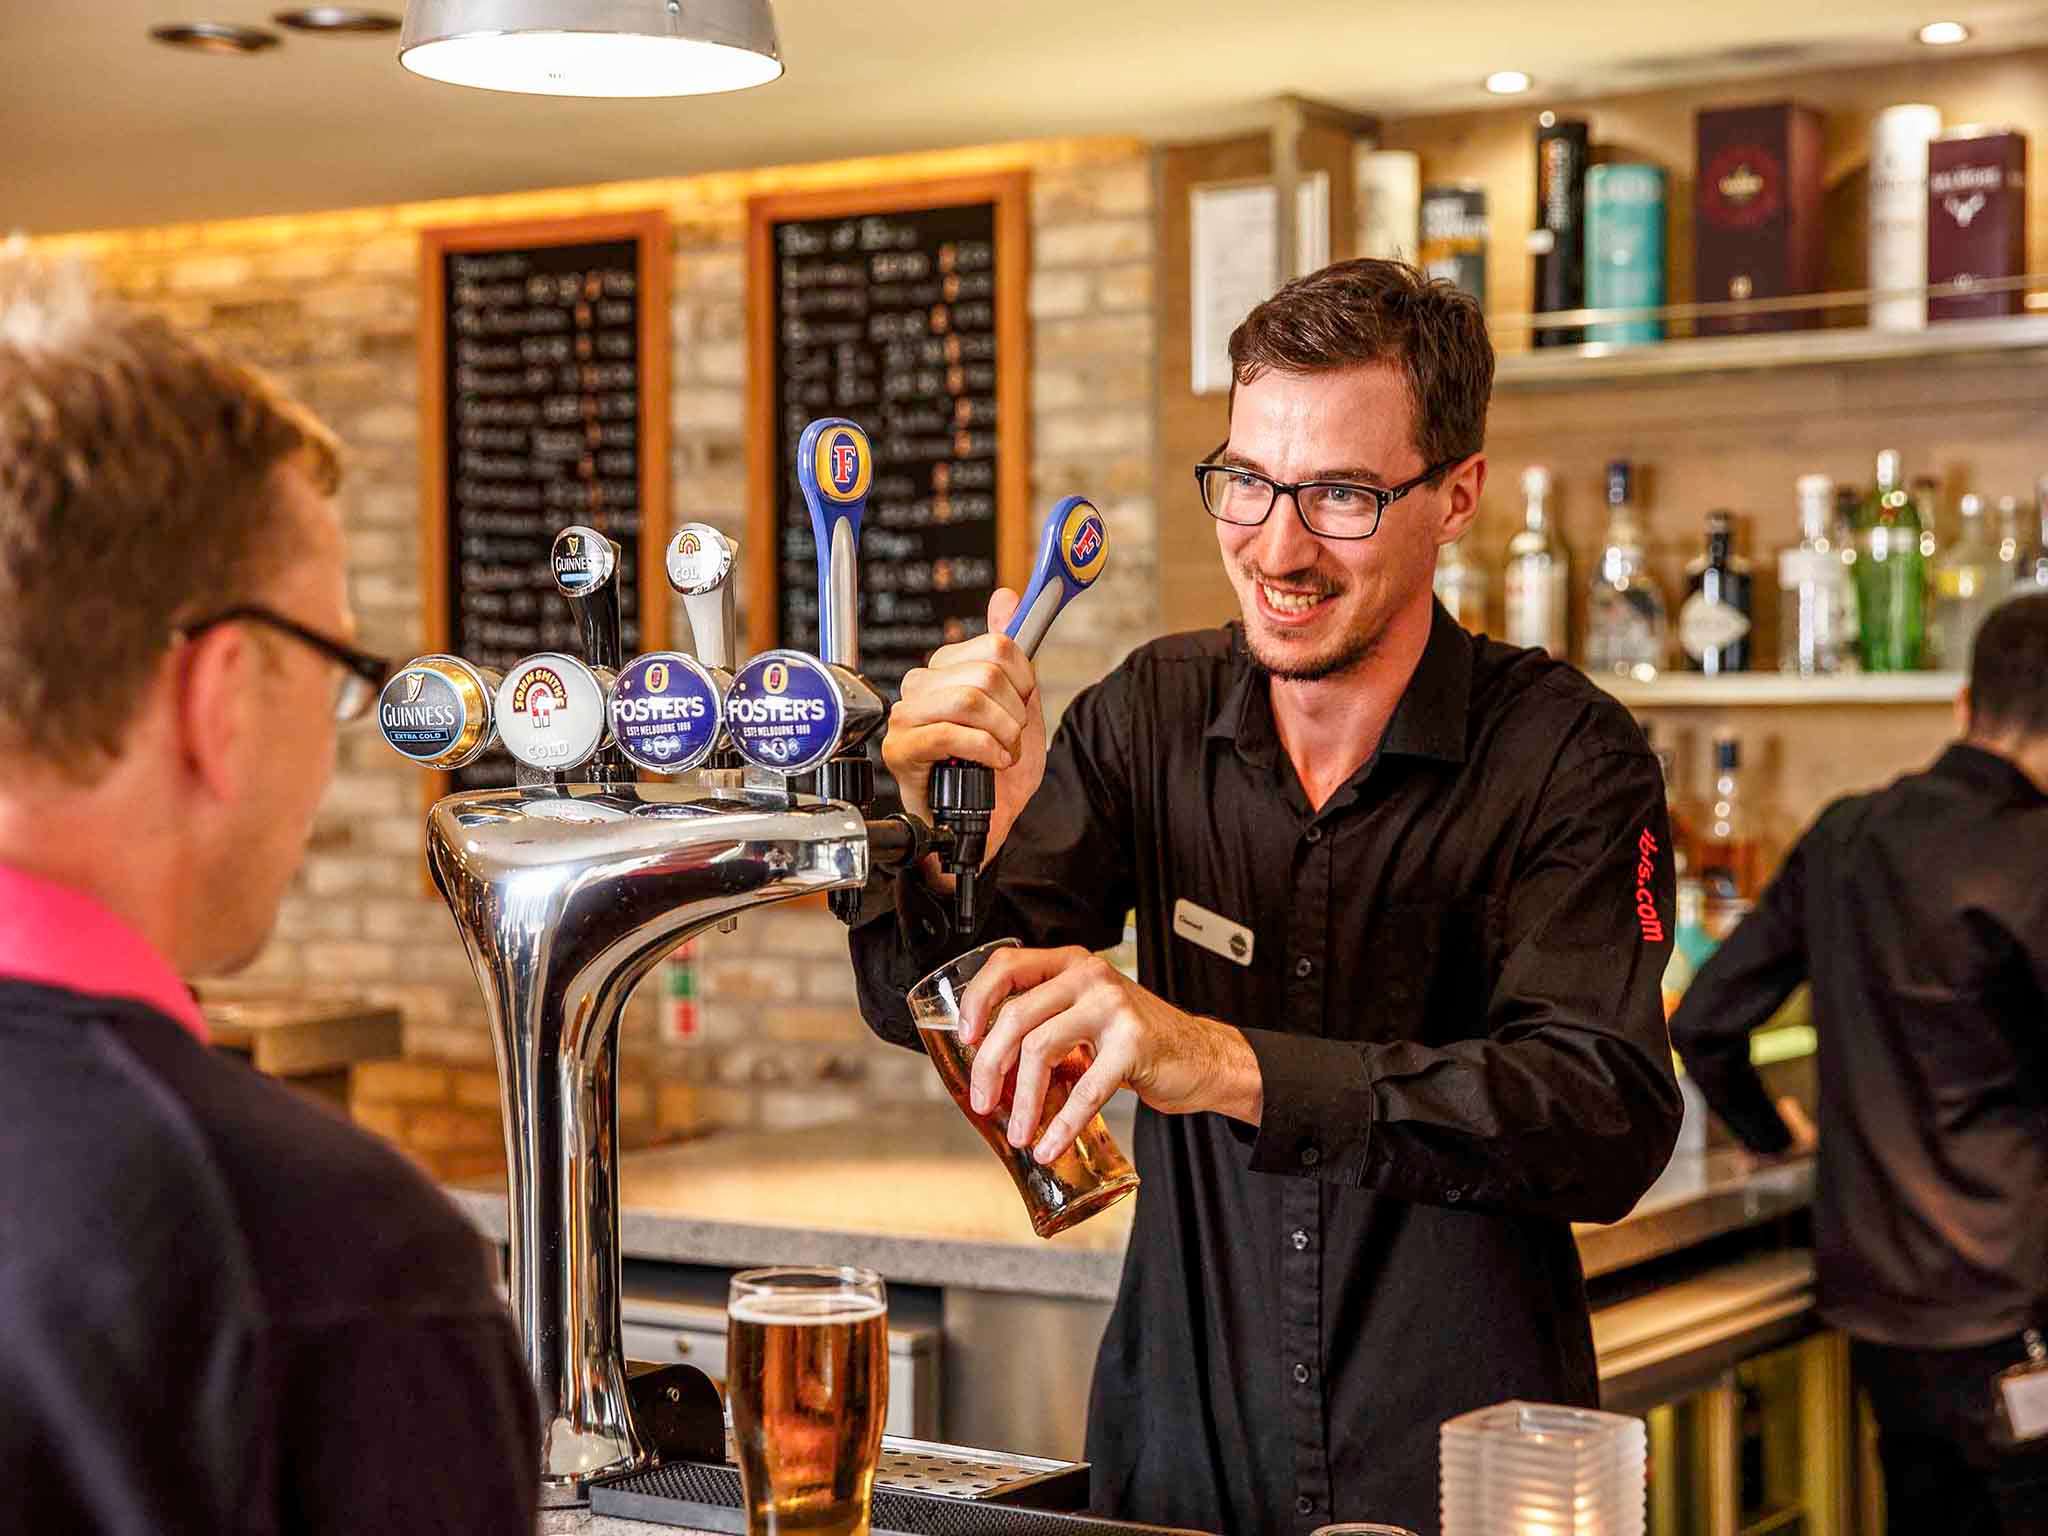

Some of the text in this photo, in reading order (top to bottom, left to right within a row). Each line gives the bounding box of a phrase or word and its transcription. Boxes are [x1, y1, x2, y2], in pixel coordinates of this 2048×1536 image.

[833, 445, 857, 484] F
[1072, 521, 1102, 560] F
[555, 556, 593, 572] GUINNES
[674, 567, 698, 582] COL
[513, 671, 535, 711] JOHN
[382, 703, 455, 727] GUINNESS
[611, 696, 705, 722] FOSTER'S
[727, 697, 826, 723] FOSTER'S
[418, 732, 441, 740] COLD
[527, 742, 570, 760] COLD
[1635, 826, 1665, 942] ibis.com
